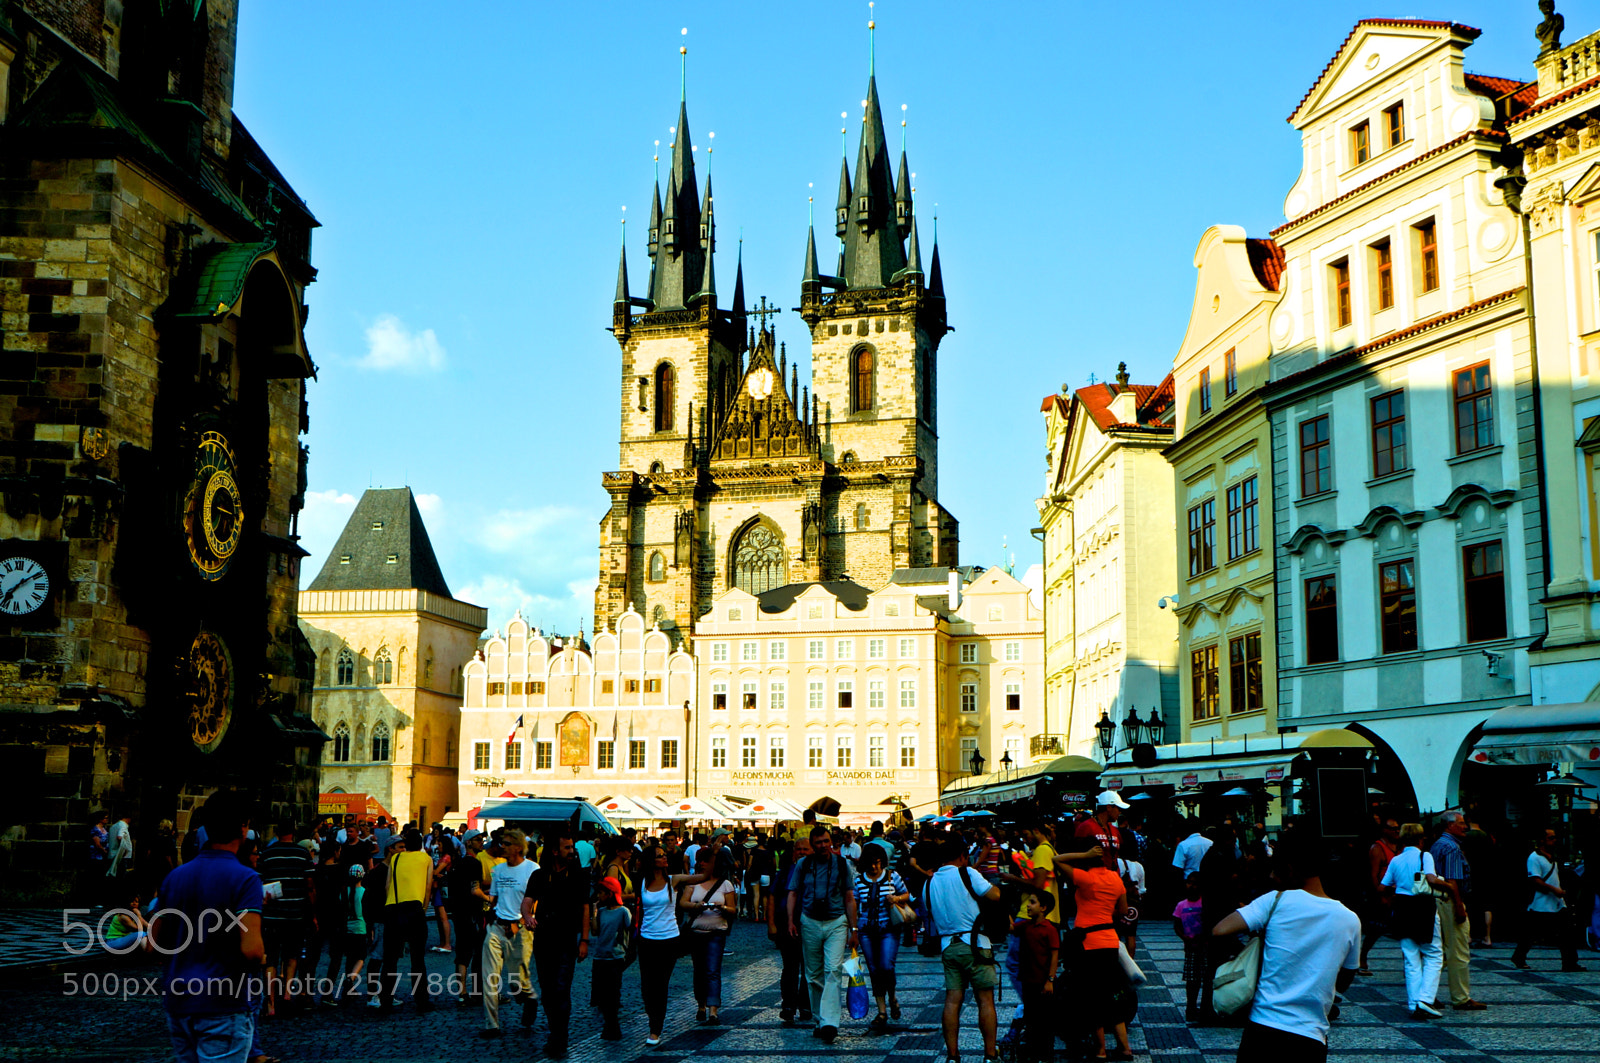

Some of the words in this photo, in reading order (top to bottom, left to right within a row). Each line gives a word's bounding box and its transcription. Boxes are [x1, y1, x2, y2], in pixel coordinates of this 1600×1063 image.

[732, 771, 764, 780] ALFONS
[764, 771, 795, 780] MUCHA
[826, 771, 873, 779] SALVADOR
[874, 769, 895, 779] DALÍ
